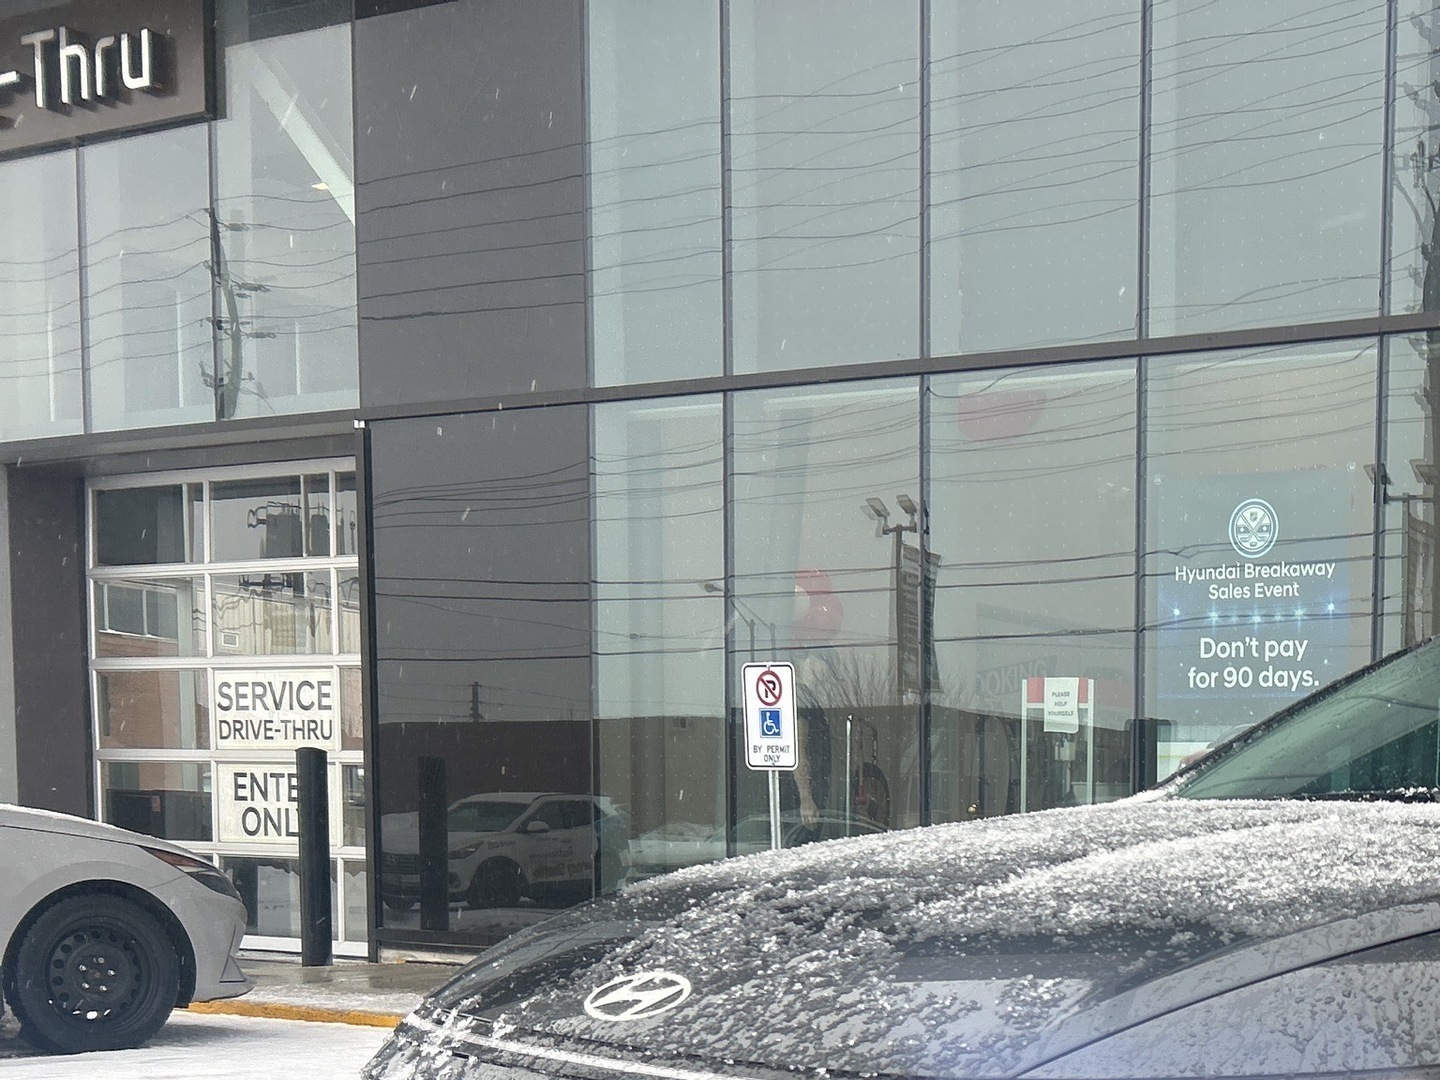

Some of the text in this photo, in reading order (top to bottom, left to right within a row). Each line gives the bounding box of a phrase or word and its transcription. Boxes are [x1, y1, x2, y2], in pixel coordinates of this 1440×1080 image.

[1175, 561, 1336, 584] Hyundai Breakaway
[1208, 581, 1300, 599] Sales Event
[1200, 637, 1309, 662] Don't pay
[1187, 665, 1320, 691] for 90 days.
[217, 680, 333, 712] SERVICE
[218, 719, 333, 740] DRIVE-THRU
[753, 745, 790, 753] BY PERMIT
[764, 754, 781, 762] ONLY
[233, 772, 299, 802] ENTE
[241, 806, 300, 837] ONL
